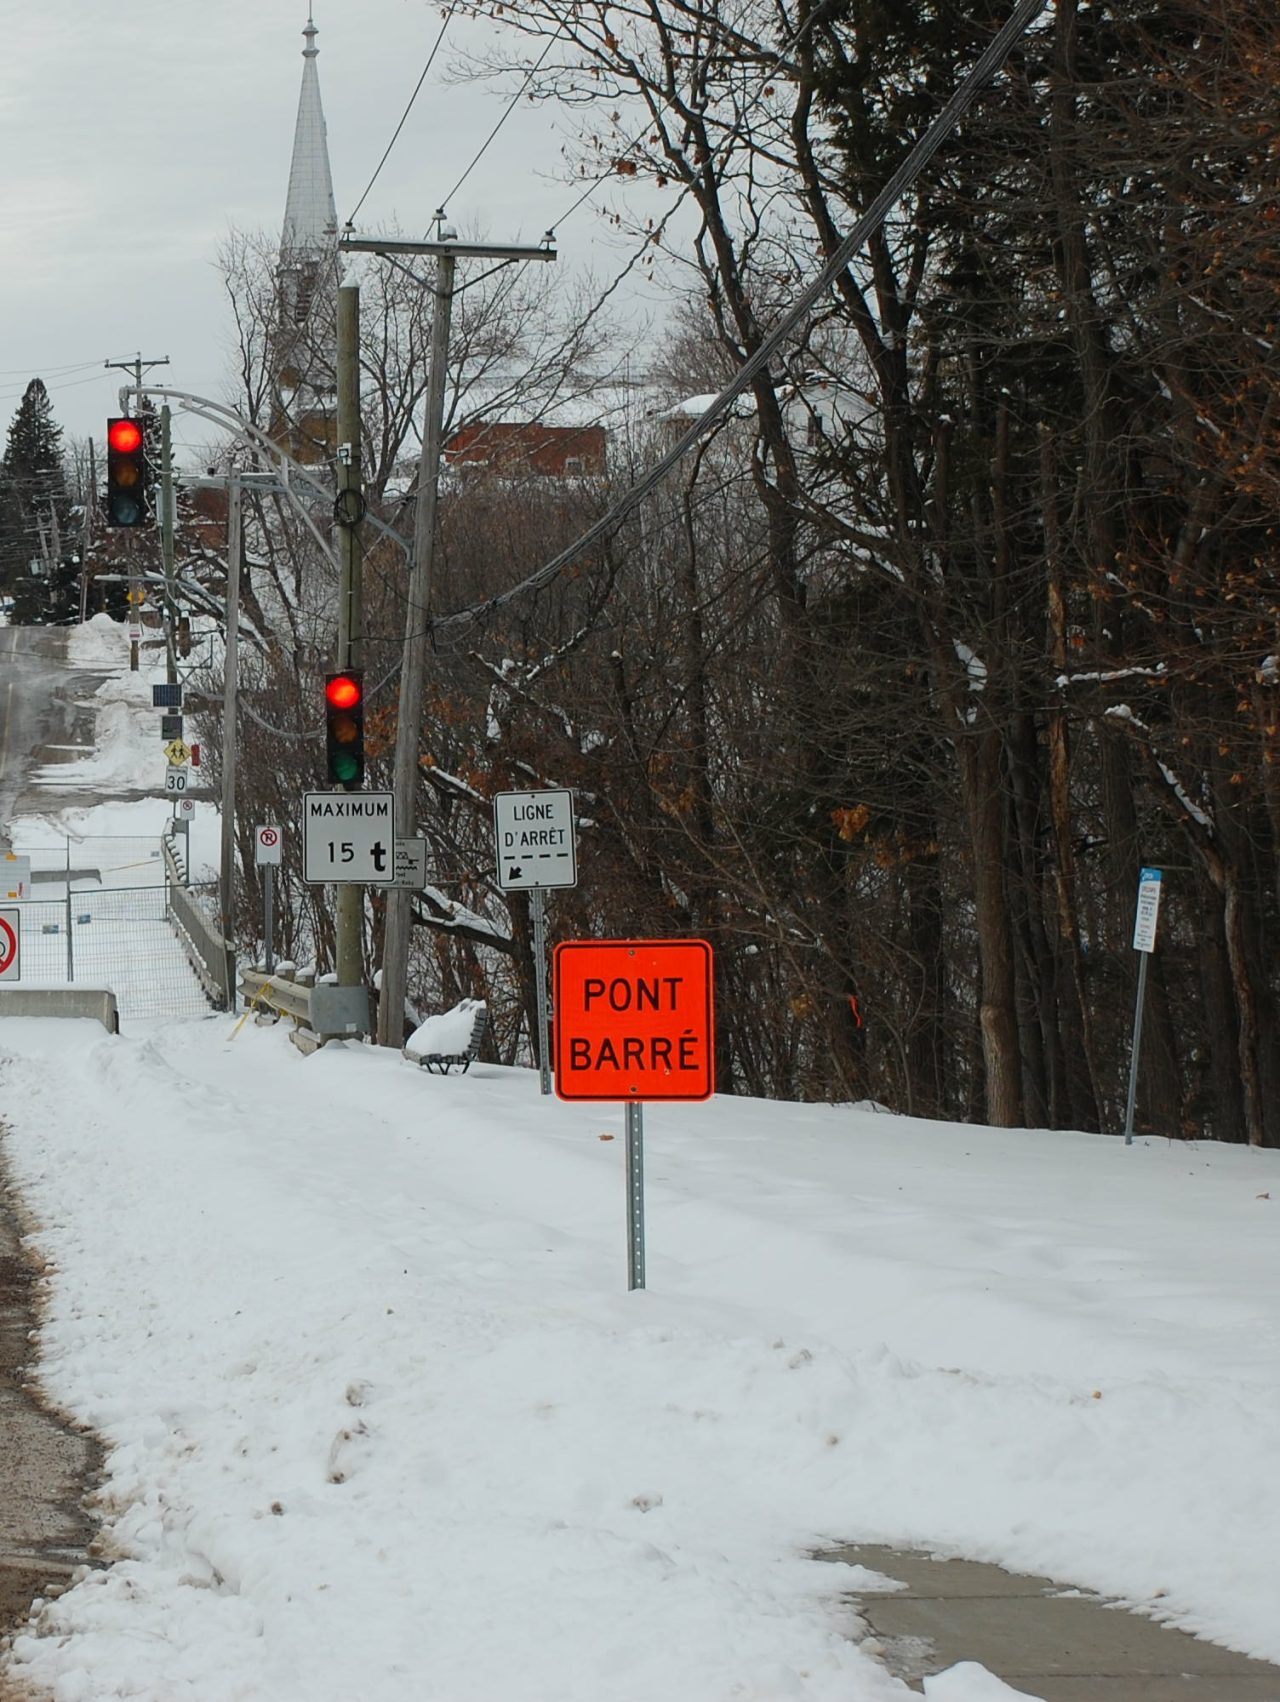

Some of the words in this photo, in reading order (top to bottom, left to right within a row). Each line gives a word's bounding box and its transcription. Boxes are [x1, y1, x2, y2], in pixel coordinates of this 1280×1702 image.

[167, 775, 186, 791] 30
[311, 802, 388, 817] MAXIMUM
[513, 804, 555, 821] LIGNE
[504, 826, 566, 847] D'ARRÊT
[328, 841, 355, 863] 15
[370, 841, 387, 872] t
[584, 977, 683, 1012] PONT
[570, 1029, 699, 1071] BARRÉ
